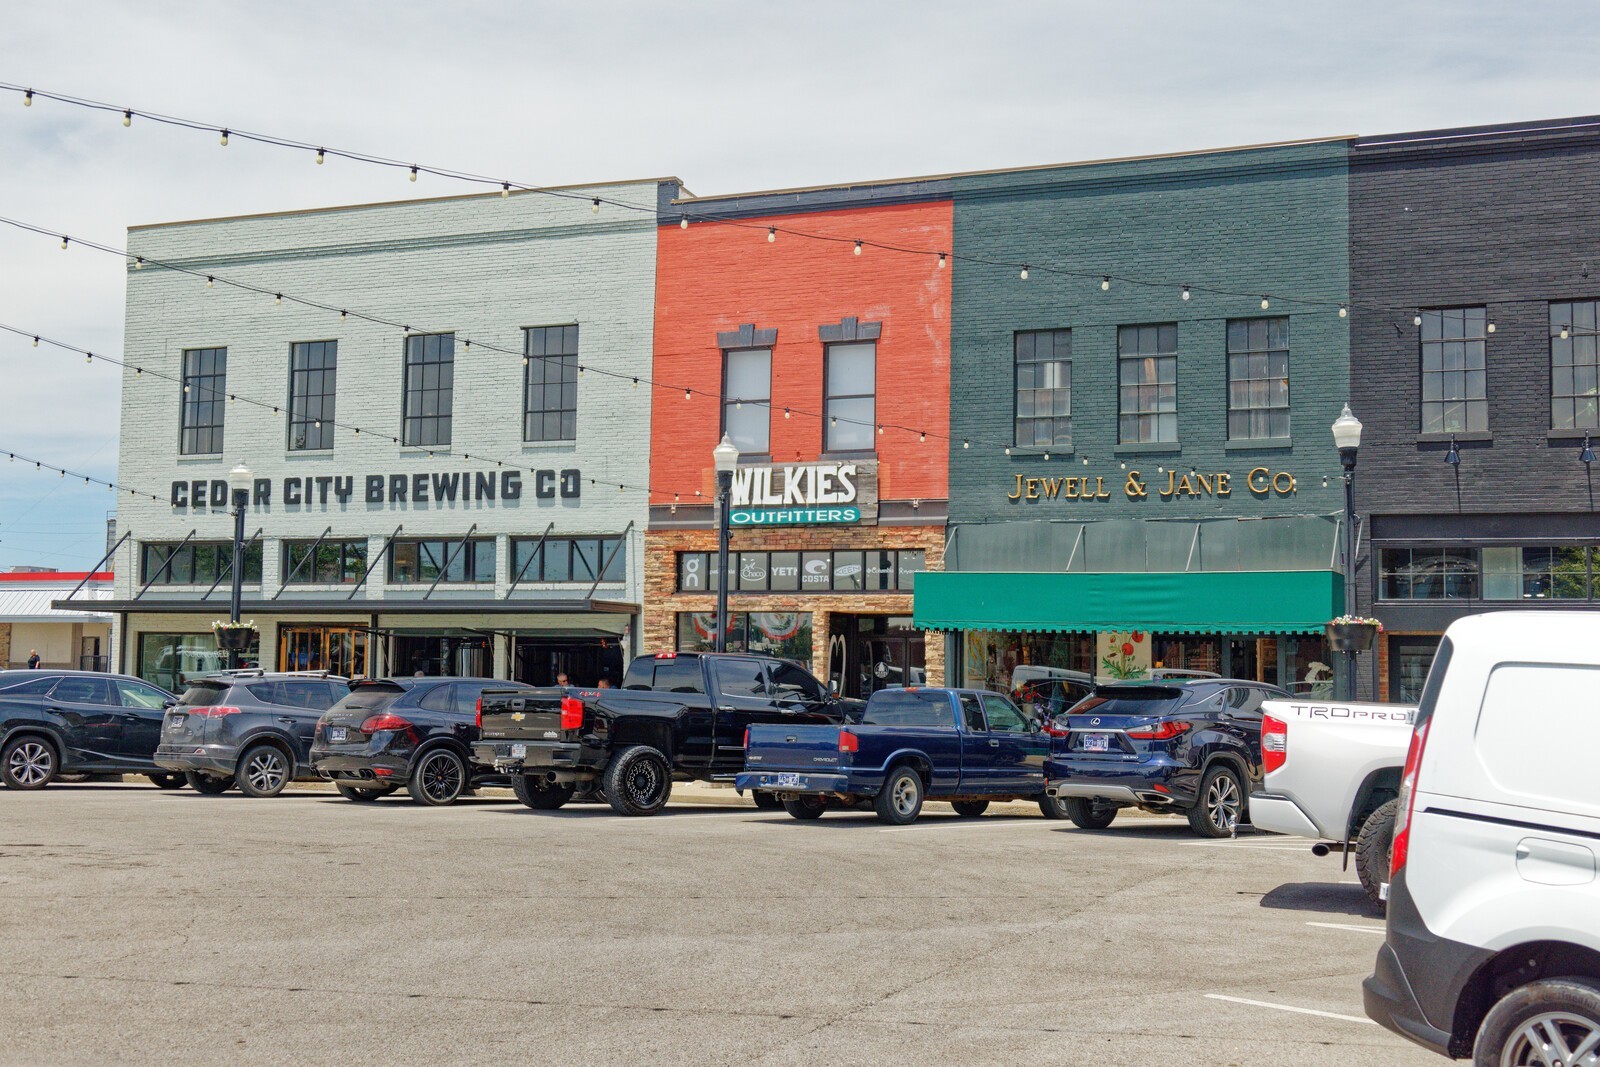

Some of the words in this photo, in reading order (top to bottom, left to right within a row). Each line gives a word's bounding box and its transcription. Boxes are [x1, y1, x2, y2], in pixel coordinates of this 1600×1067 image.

[171, 478, 272, 507] CEDR
[283, 475, 354, 505] CITY
[365, 470, 522, 503] BREWING
[535, 468, 581, 499] CO
[732, 462, 857, 506] WILKIE'S
[1008, 474, 1111, 499] JEWELL
[1124, 471, 1148, 497] &
[1158, 470, 1232, 496] JANE
[731, 508, 856, 524] OUTFITTERS
[835, 565, 861, 575] KEEN
[802, 575, 830, 583] COSTA
[1290, 705, 1350, 720] TRD
[1353, 711, 1406, 721] PRO
